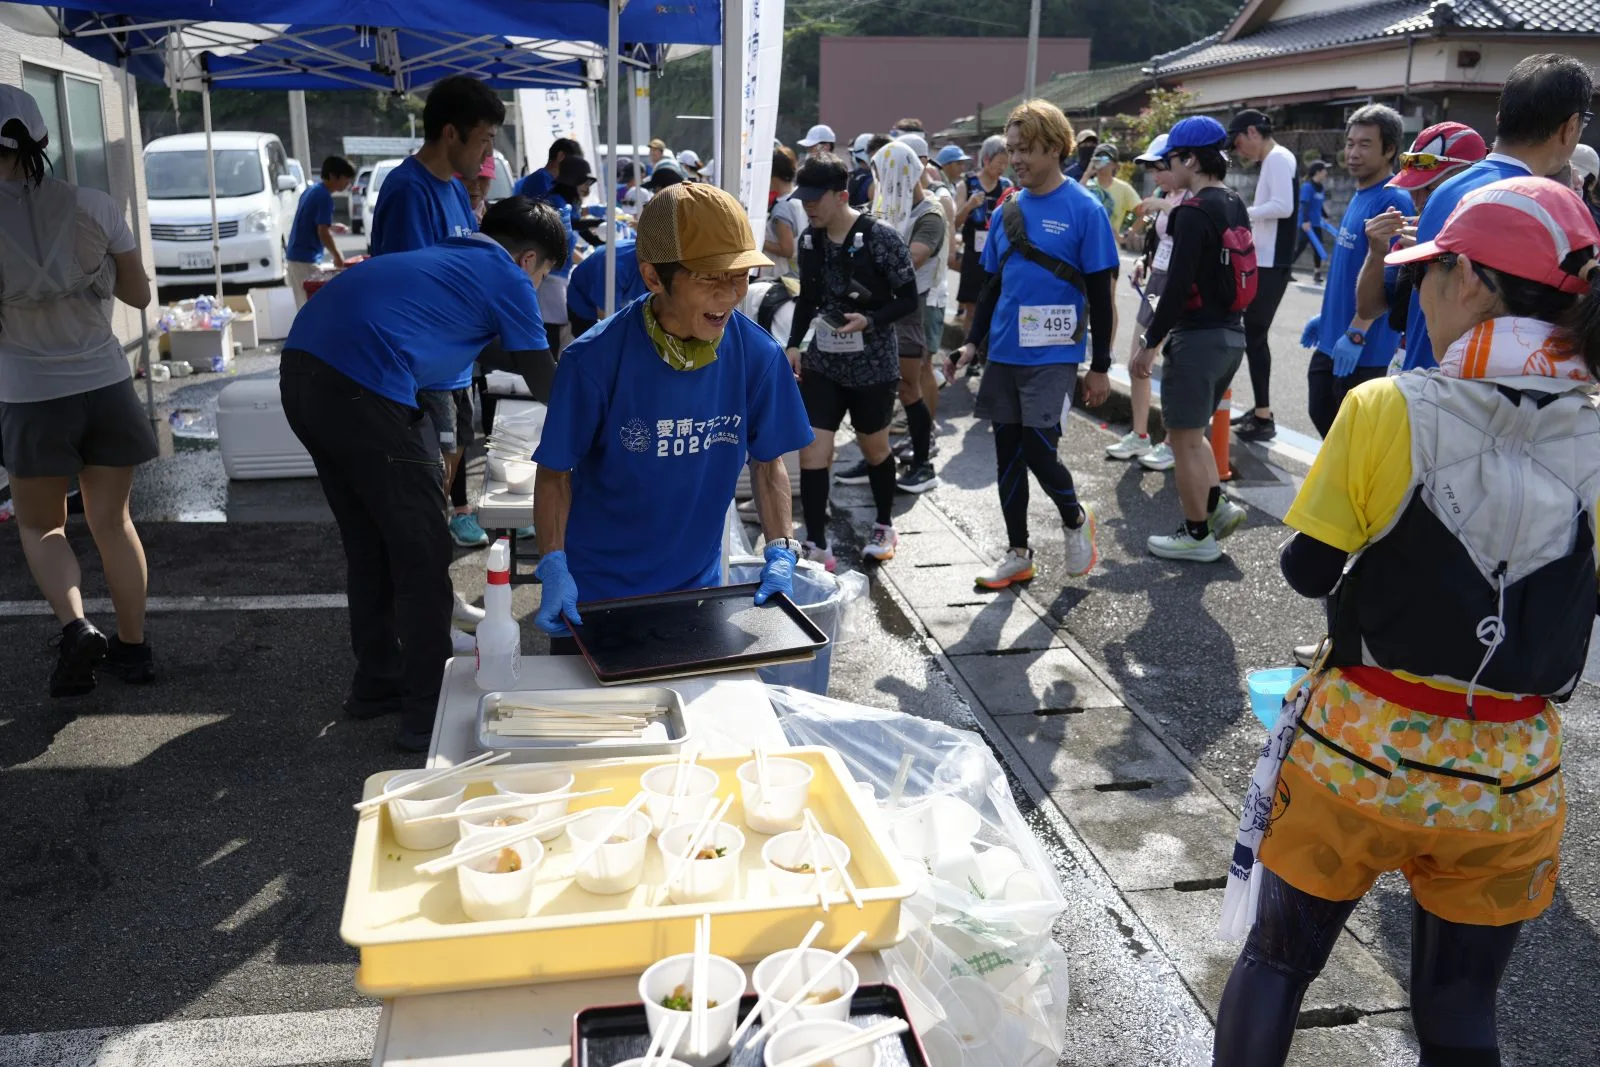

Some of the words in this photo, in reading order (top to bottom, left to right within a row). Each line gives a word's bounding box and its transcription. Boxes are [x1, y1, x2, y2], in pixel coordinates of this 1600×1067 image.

[1043, 317, 1072, 331] 495
[656, 414, 742, 437] 愛南マラニック
[657, 433, 711, 457] 2026
[1442, 483, 1455, 500] TR
